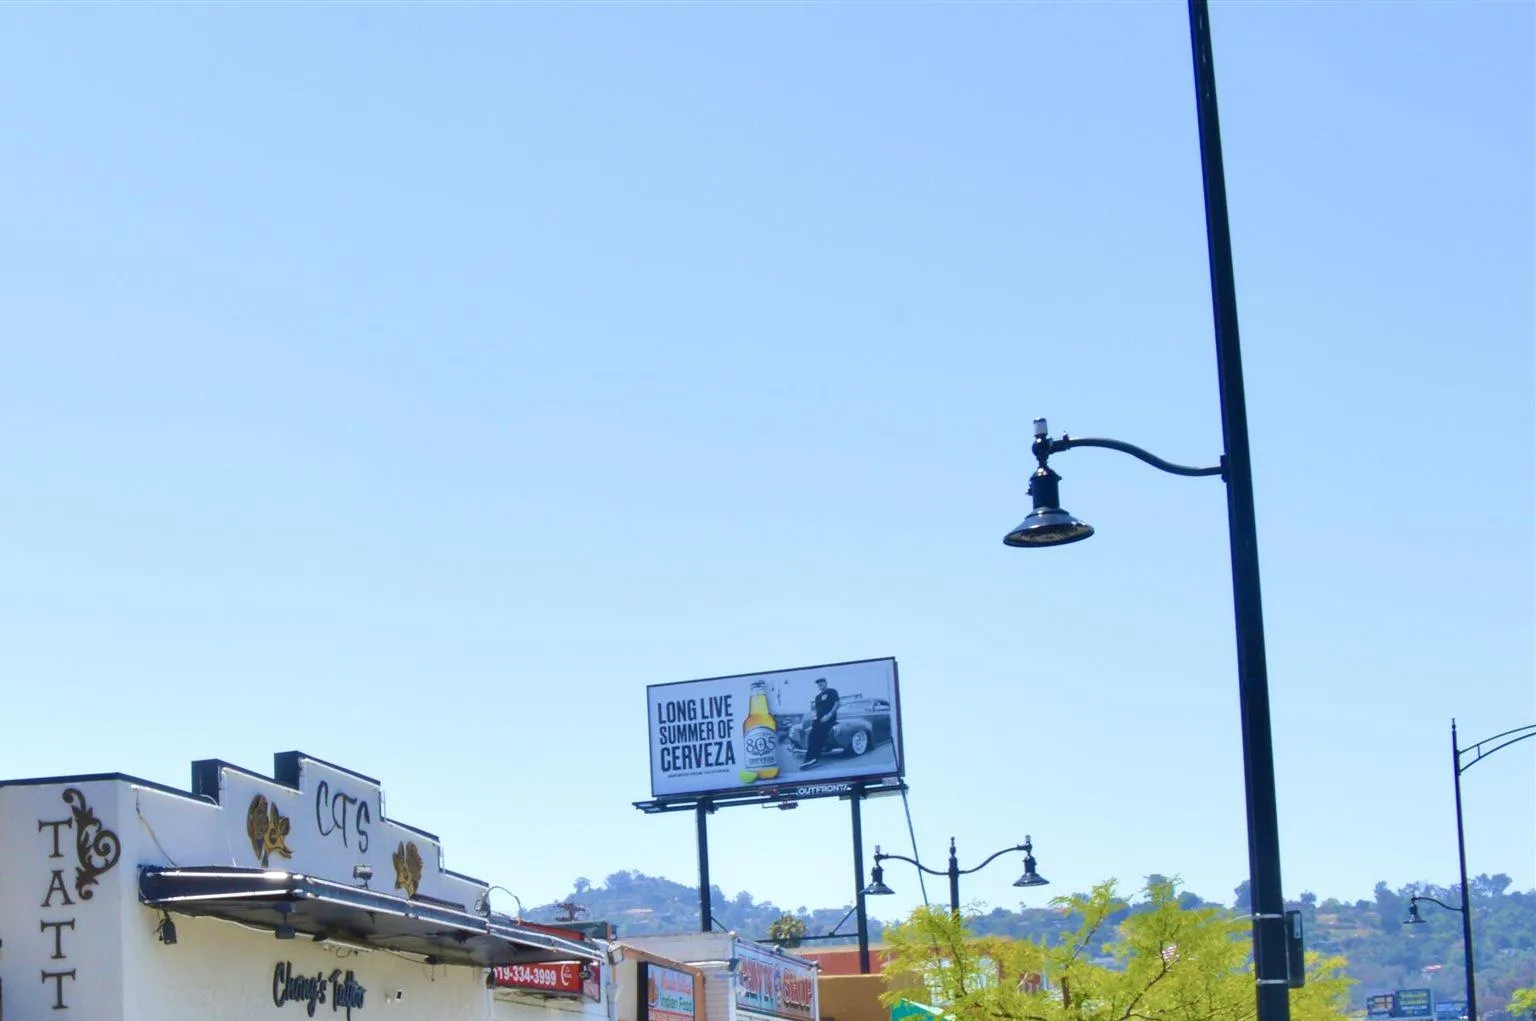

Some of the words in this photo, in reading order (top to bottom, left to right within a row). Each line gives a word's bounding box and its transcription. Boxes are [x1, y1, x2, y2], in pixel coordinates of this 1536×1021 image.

[657, 698, 697, 724] LONG
[700, 694, 733, 719] LIVE
[659, 722, 715, 745] SUMMER
[718, 719, 734, 738] OF
[660, 741, 735, 772] CERVEZA
[316, 781, 371, 854] CTS
